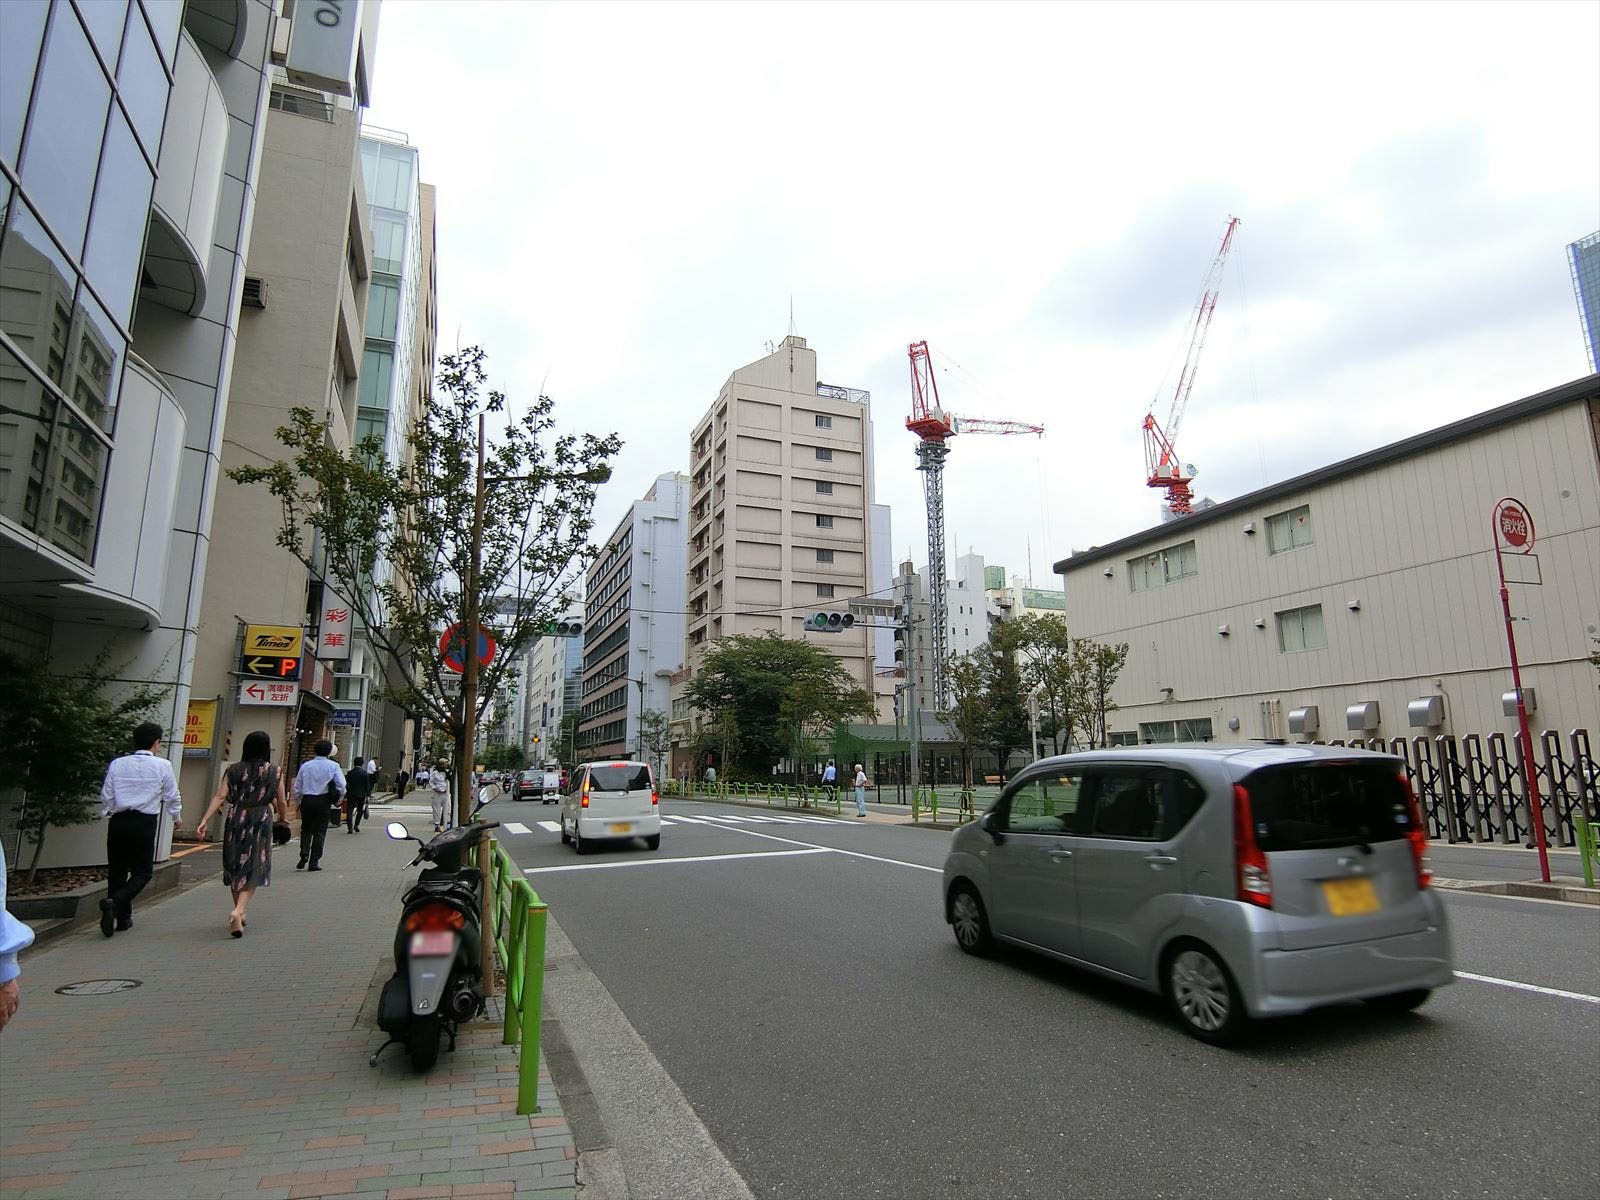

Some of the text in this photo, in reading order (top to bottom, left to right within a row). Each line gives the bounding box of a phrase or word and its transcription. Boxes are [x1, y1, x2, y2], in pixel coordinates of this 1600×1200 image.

[1502, 518, 1526, 536] 消火栓
[323, 608, 348, 647] 彩華
[256, 634, 295, 649] Times
[281, 659, 296, 676] P
[266, 684, 294, 693] 満車時
[271, 693, 289, 702] 左折
